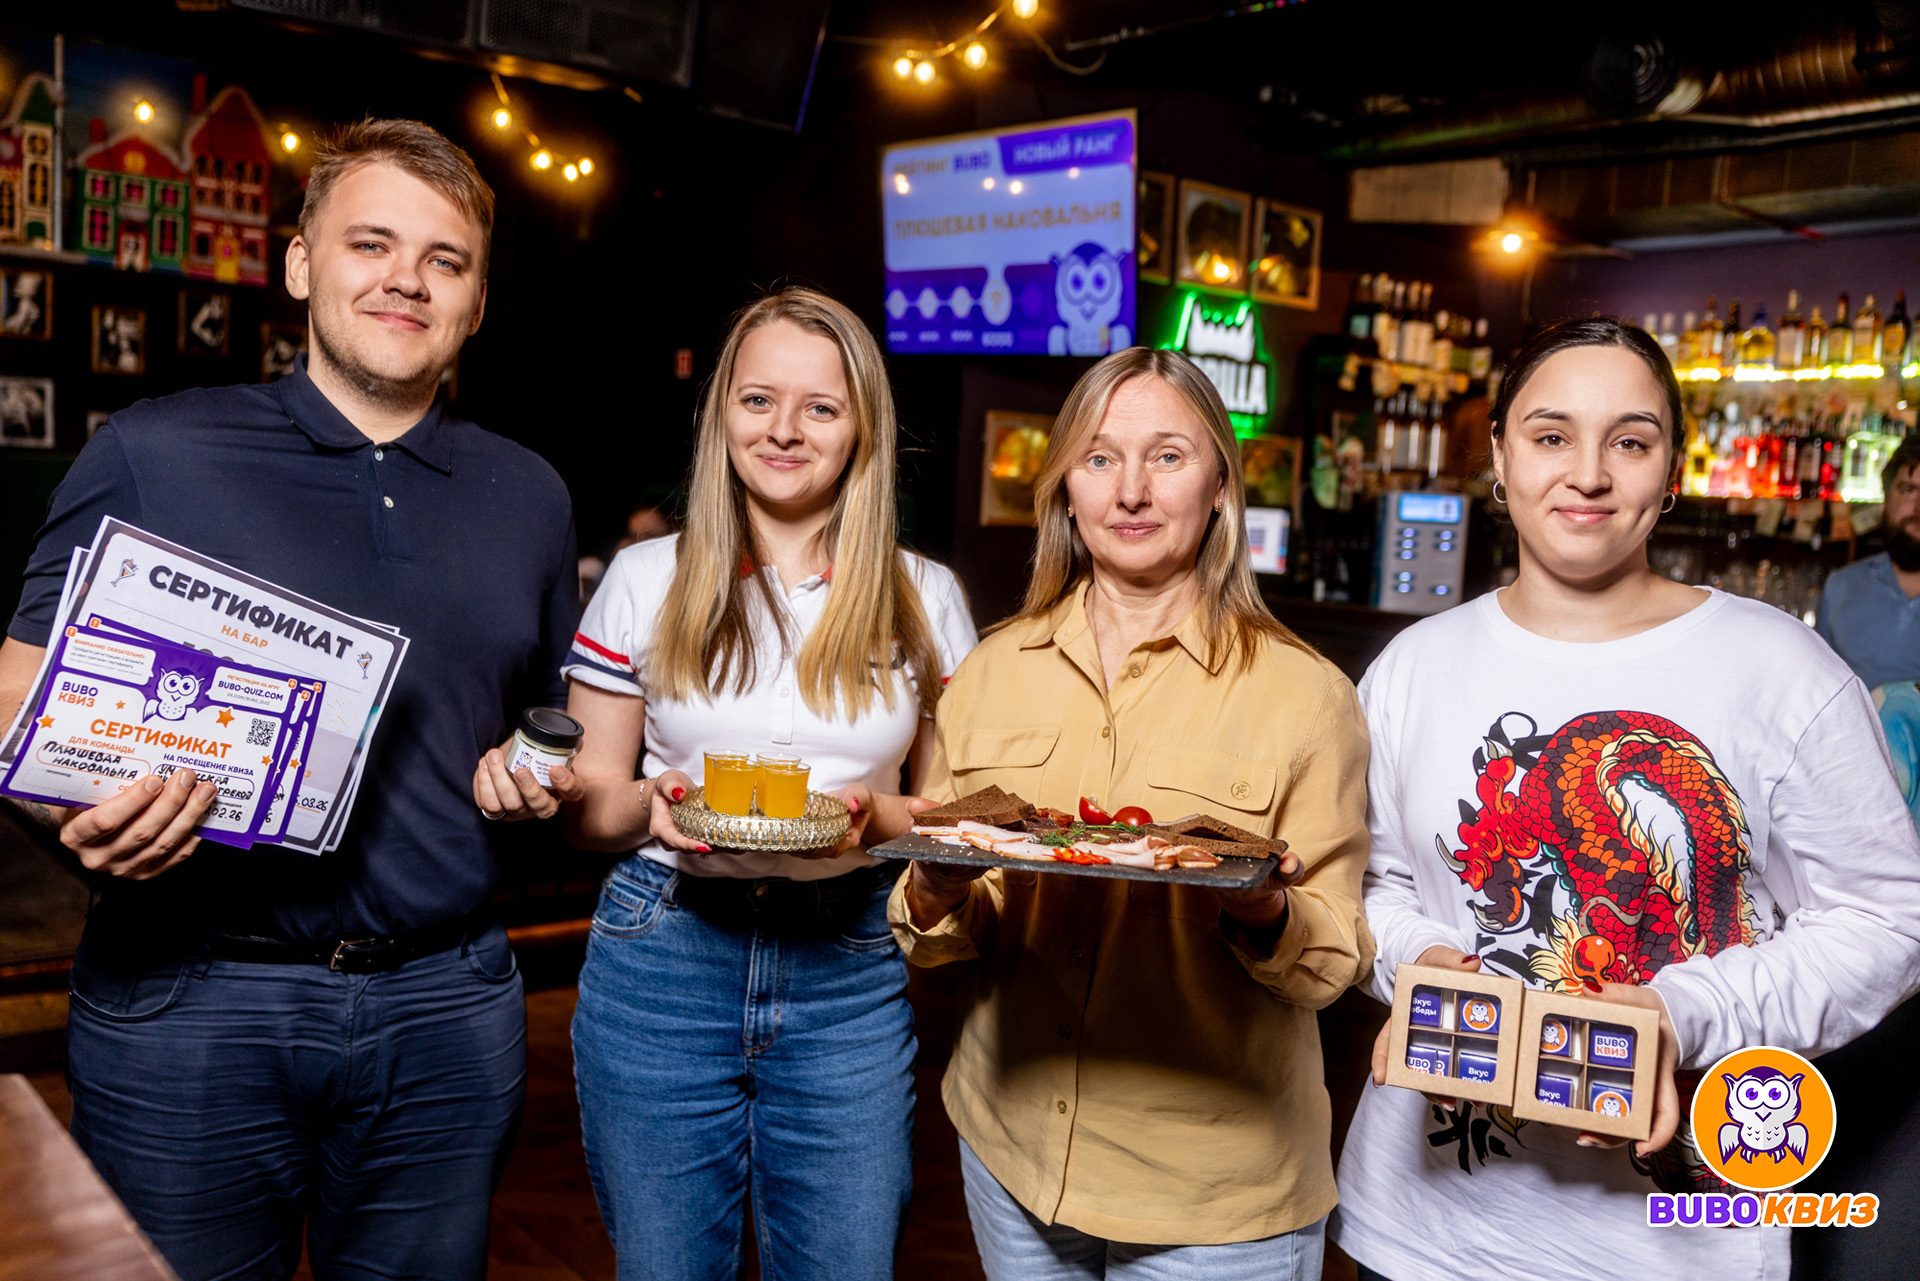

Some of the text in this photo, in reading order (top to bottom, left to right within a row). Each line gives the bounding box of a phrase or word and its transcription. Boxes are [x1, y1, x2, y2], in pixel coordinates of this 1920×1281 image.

[894, 201, 1122, 239] ПЛЮШЕВАЯ НАКОВАЛЬНЯ
[149, 565, 353, 659] СЕРТИФИКАТ
[221, 624, 269, 649] НА БАР
[62, 681, 98, 697] BUBO
[218, 681, 284, 701] BUBO-QUIZ.COM
[58, 692, 95, 708] КВИЗ
[68, 736, 135, 754] ДЛЯ КОМАНДЫ
[90, 719, 232, 759] СЕРТИФИКАТ
[43, 741, 122, 764] ПЛЮШЕВАЯ
[52, 757, 138, 779] НАКОВАЛЬНЯ
[163, 754, 254, 776] НА ПОСЕЩЕНИЕ КВИЗА
[1596, 1037, 1626, 1048] BUBO
[1596, 1046, 1626, 1057] КВИЗ
[1408, 1058, 1429, 1067] UBO
[1468, 1067, 1489, 1077] Вкус
[1539, 1089, 1560, 1099] Вкус
